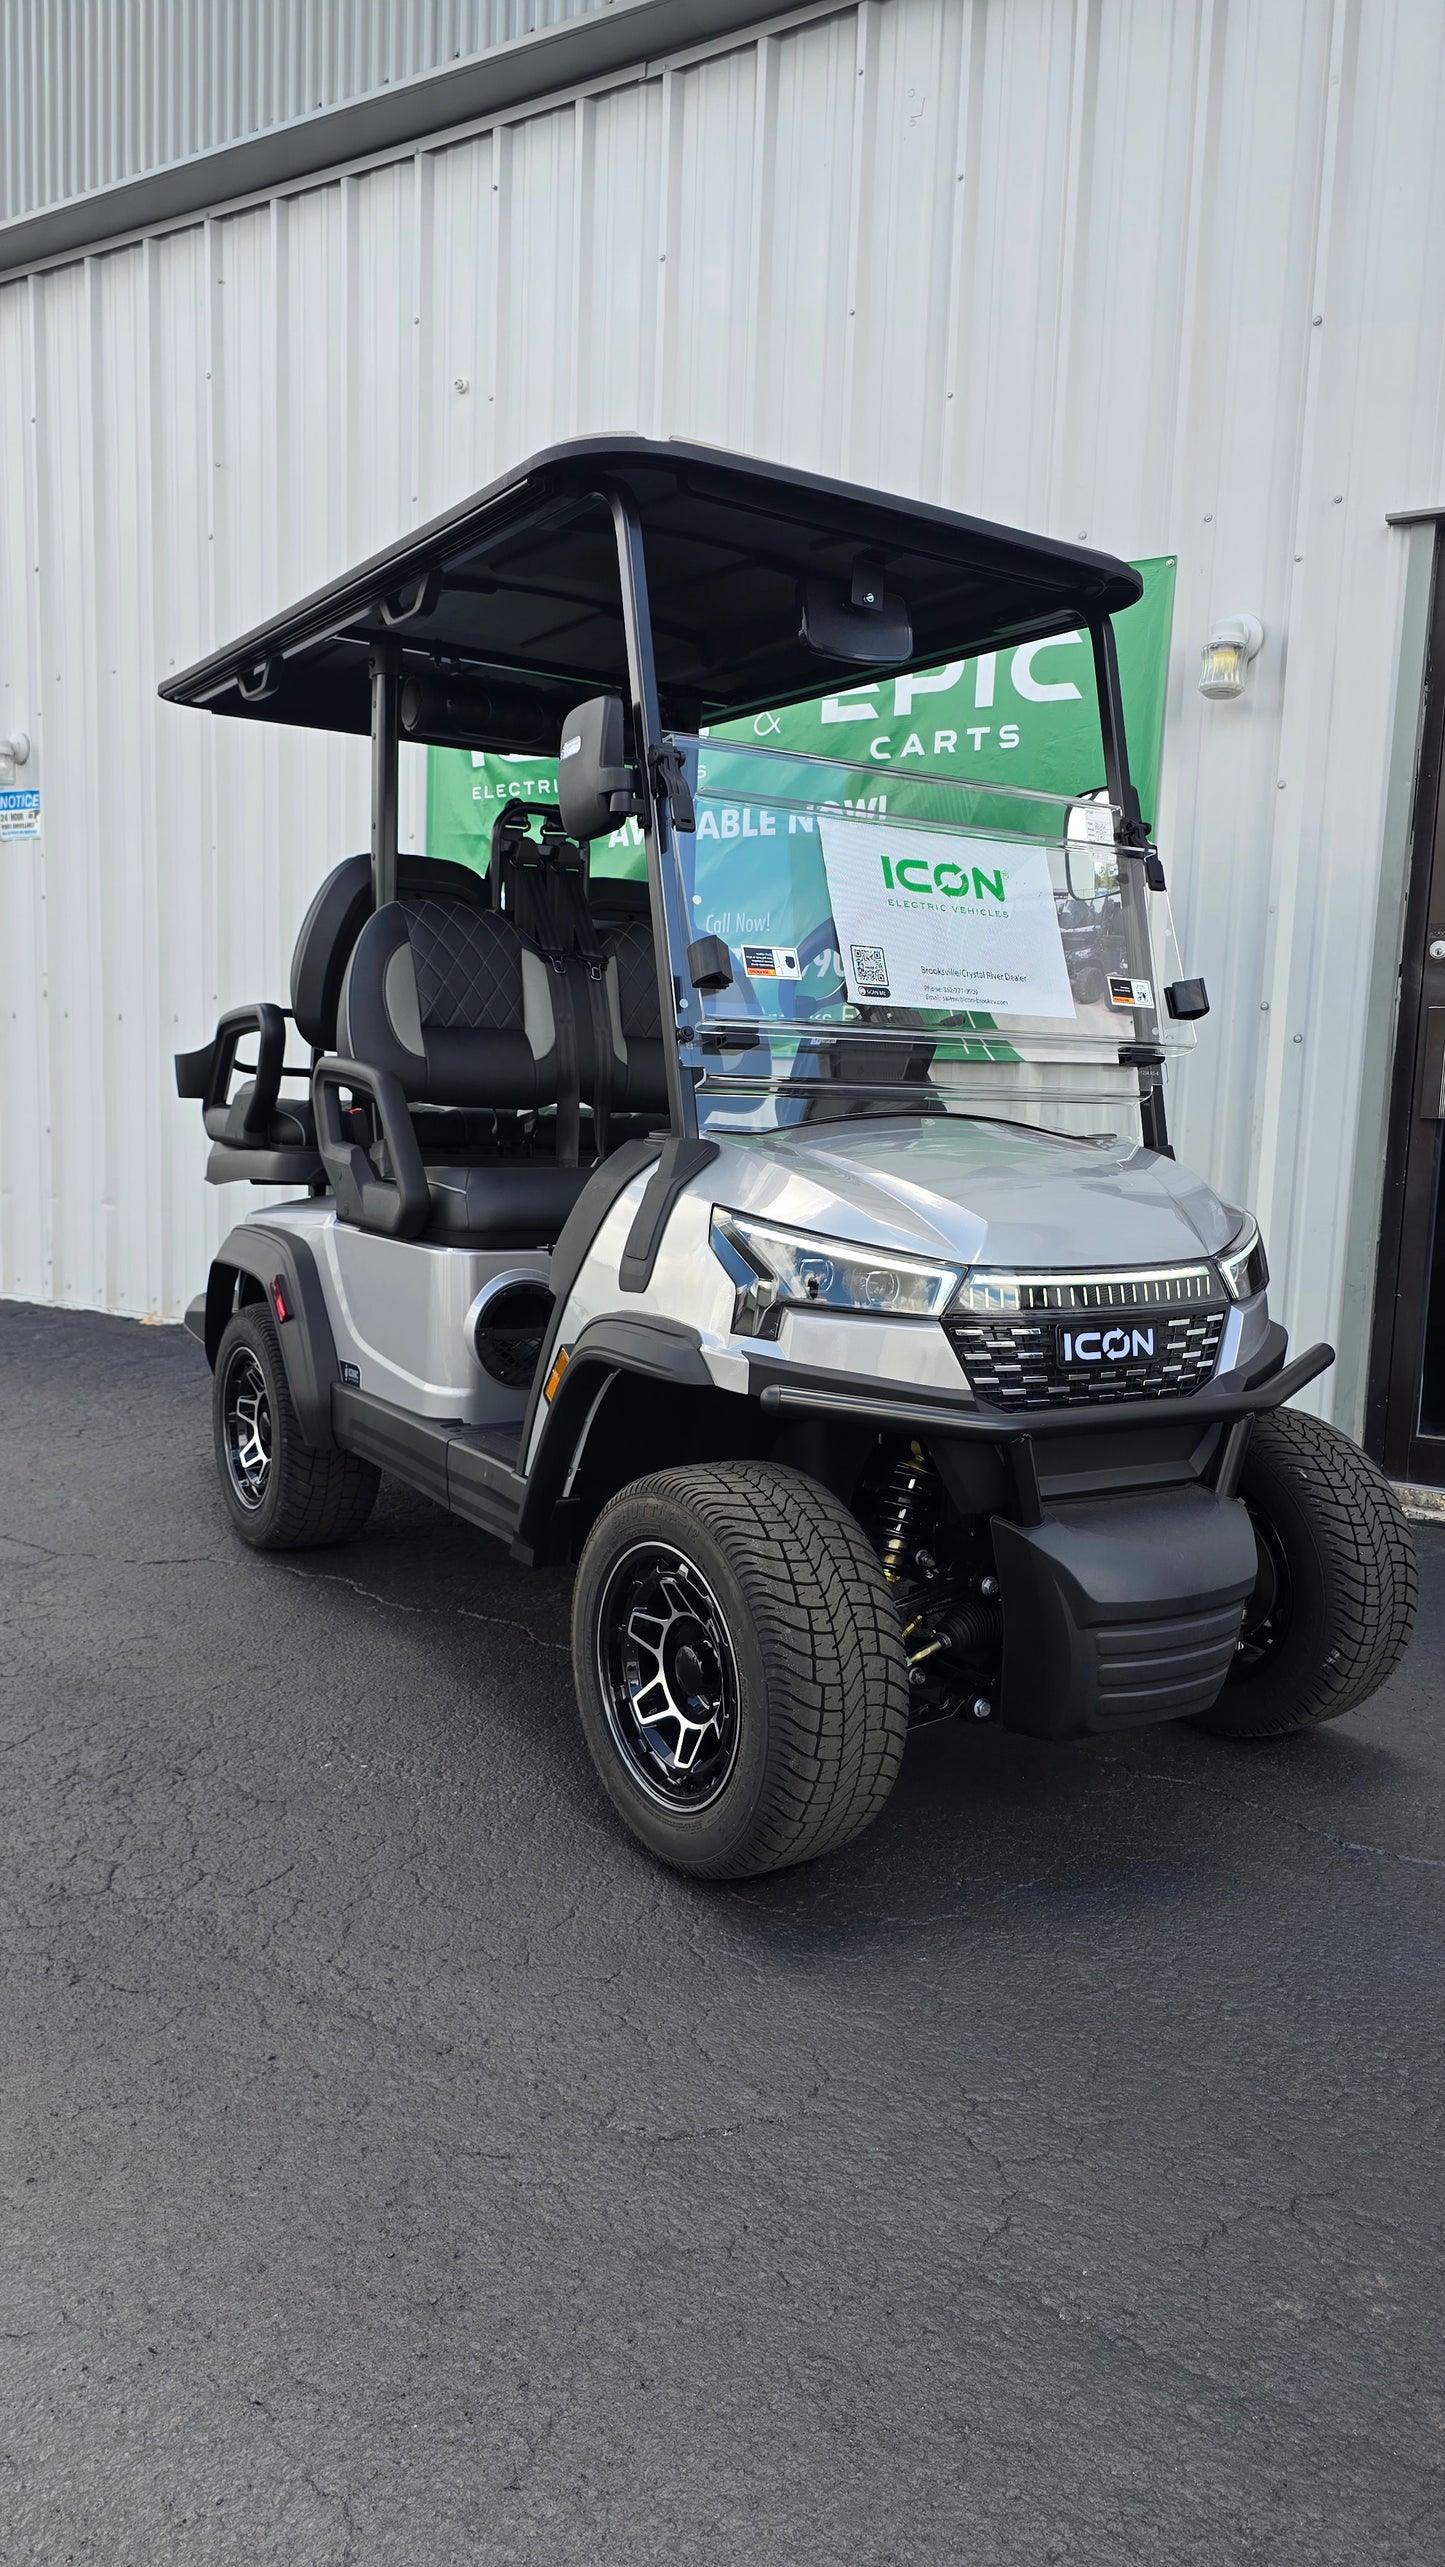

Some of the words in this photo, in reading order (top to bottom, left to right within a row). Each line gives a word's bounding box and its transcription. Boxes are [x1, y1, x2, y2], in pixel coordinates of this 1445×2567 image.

[870, 724, 1020, 760] CARTS
[472, 778, 559, 800] ELECTRI
[0, 793, 39, 809] NOTICE
[880, 855, 1006, 902] ICON
[887, 898, 947, 912] ELECTRIC
[951, 905, 1009, 918] VEHICLES
[705, 912, 731, 934] Call
[735, 912, 770, 933] Now!
[986, 971, 1004, 981] River
[1004, 972, 1027, 983] Dealer
[1063, 1327, 1154, 1361] ICON
